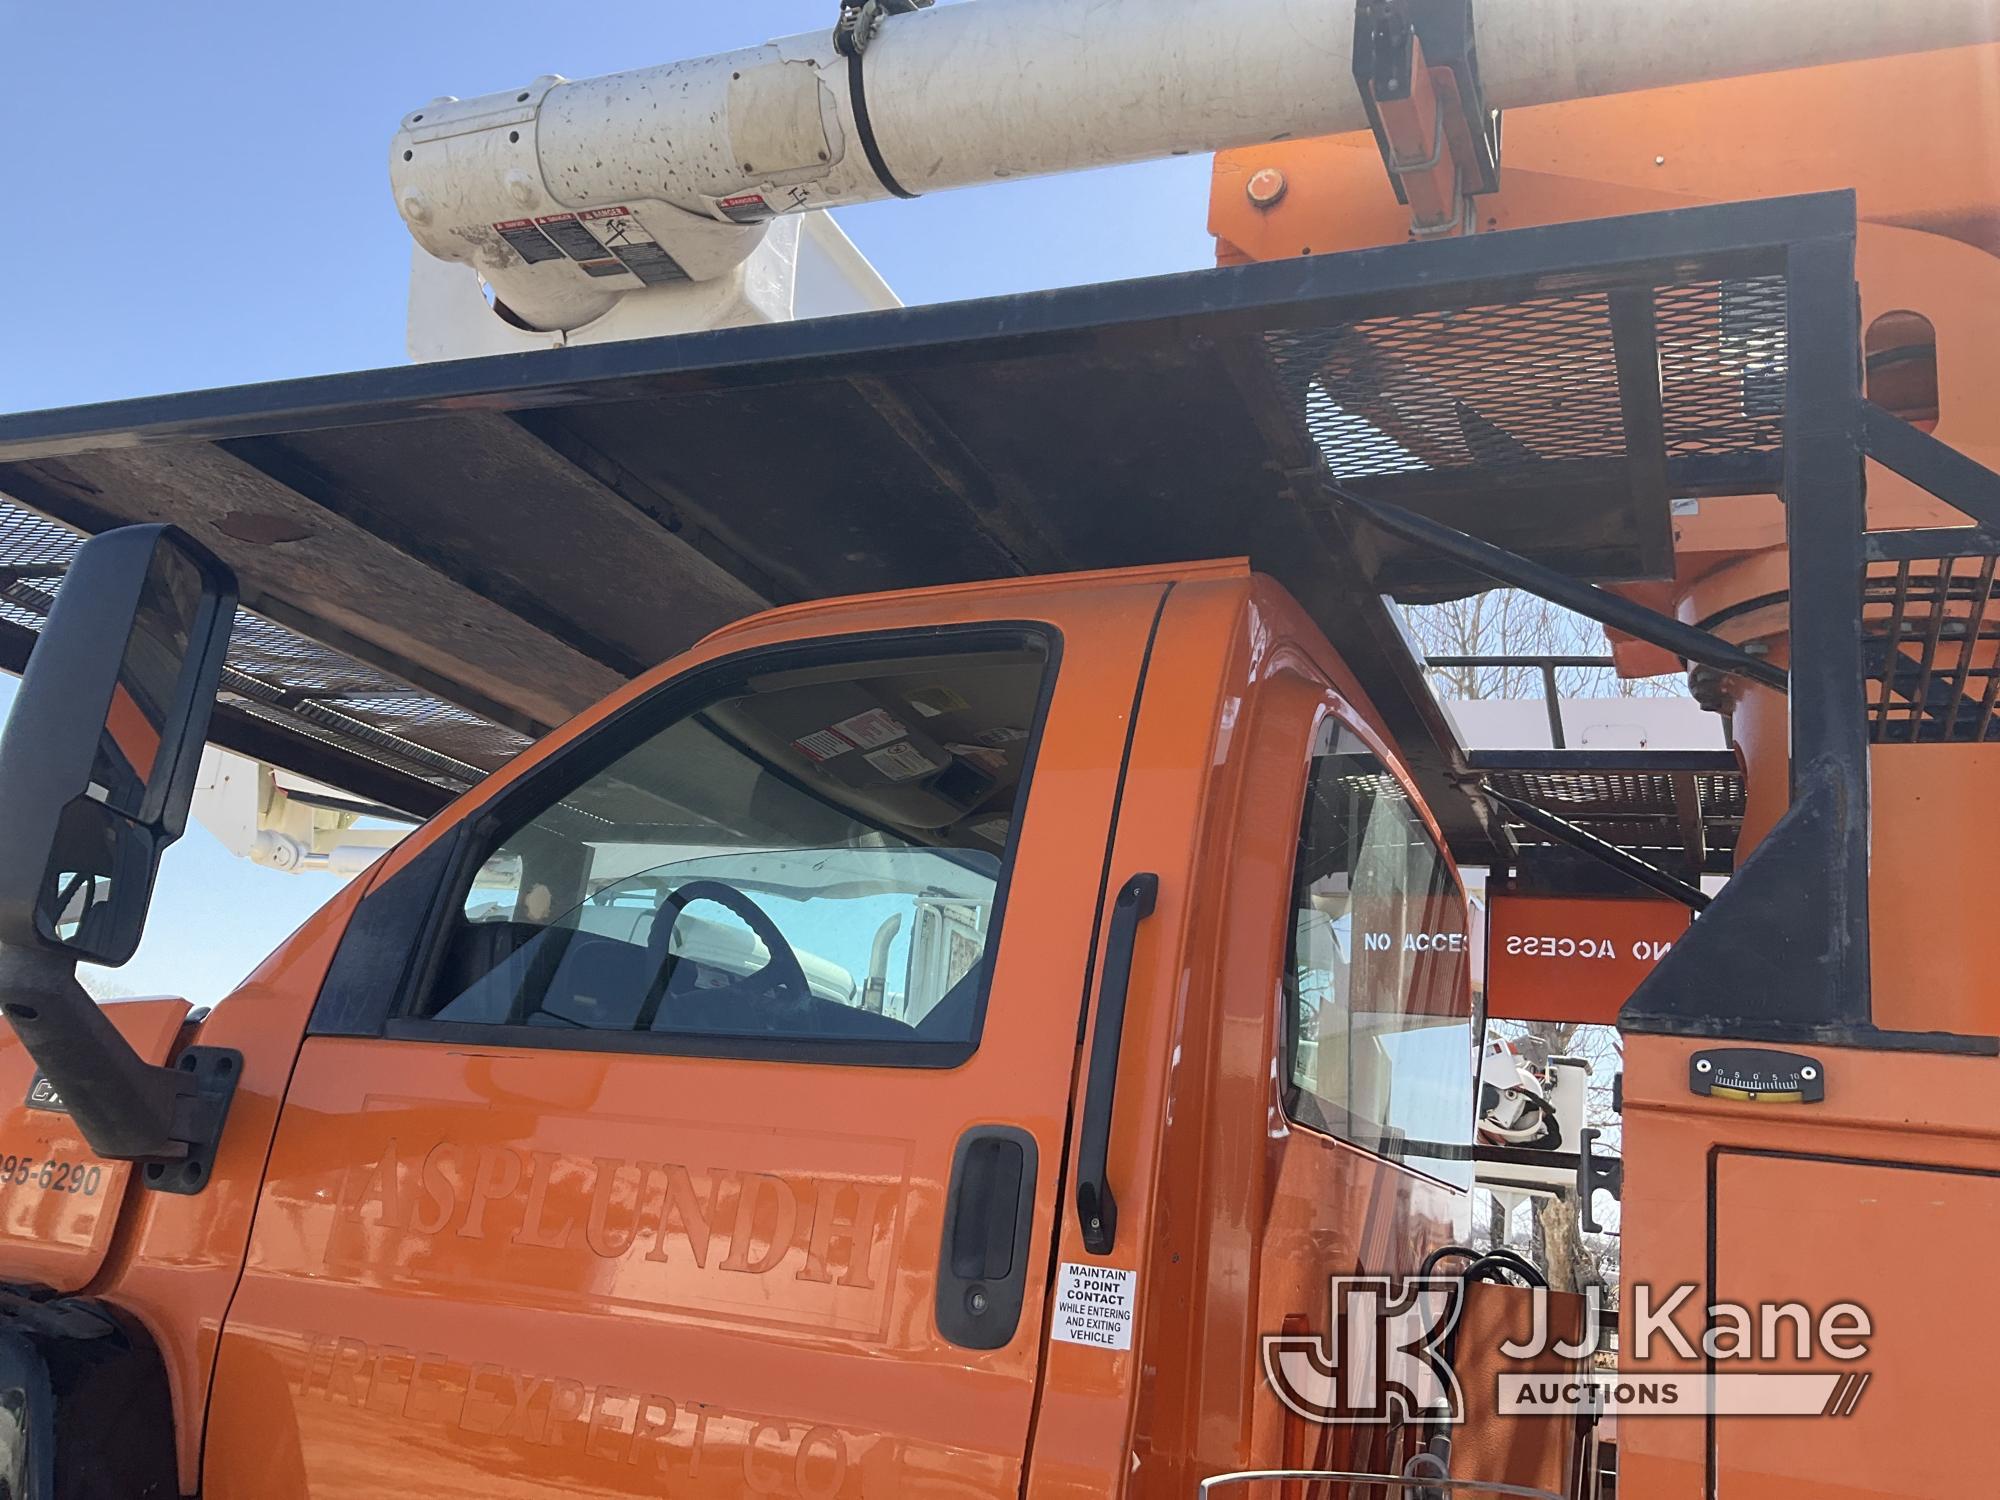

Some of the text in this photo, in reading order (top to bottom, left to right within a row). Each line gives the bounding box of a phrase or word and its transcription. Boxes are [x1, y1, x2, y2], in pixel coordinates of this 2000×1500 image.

[1364, 933, 1392, 951] NO
[0, 1153, 101, 1196] 95-6290
[344, 1136, 900, 1290] ASPLUNDH
[1069, 1265, 1126, 1280] MAINTAIN
[1073, 1278, 1120, 1292] 3 POINT
[1067, 1290, 1124, 1305] CONTACT
[1059, 1302, 1131, 1320] WHILE ENTERING
[1066, 1316, 1121, 1332] AND EXITING
[1070, 1329, 1114, 1344] VEHICLE
[458, 1360, 726, 1479] EXPERT
